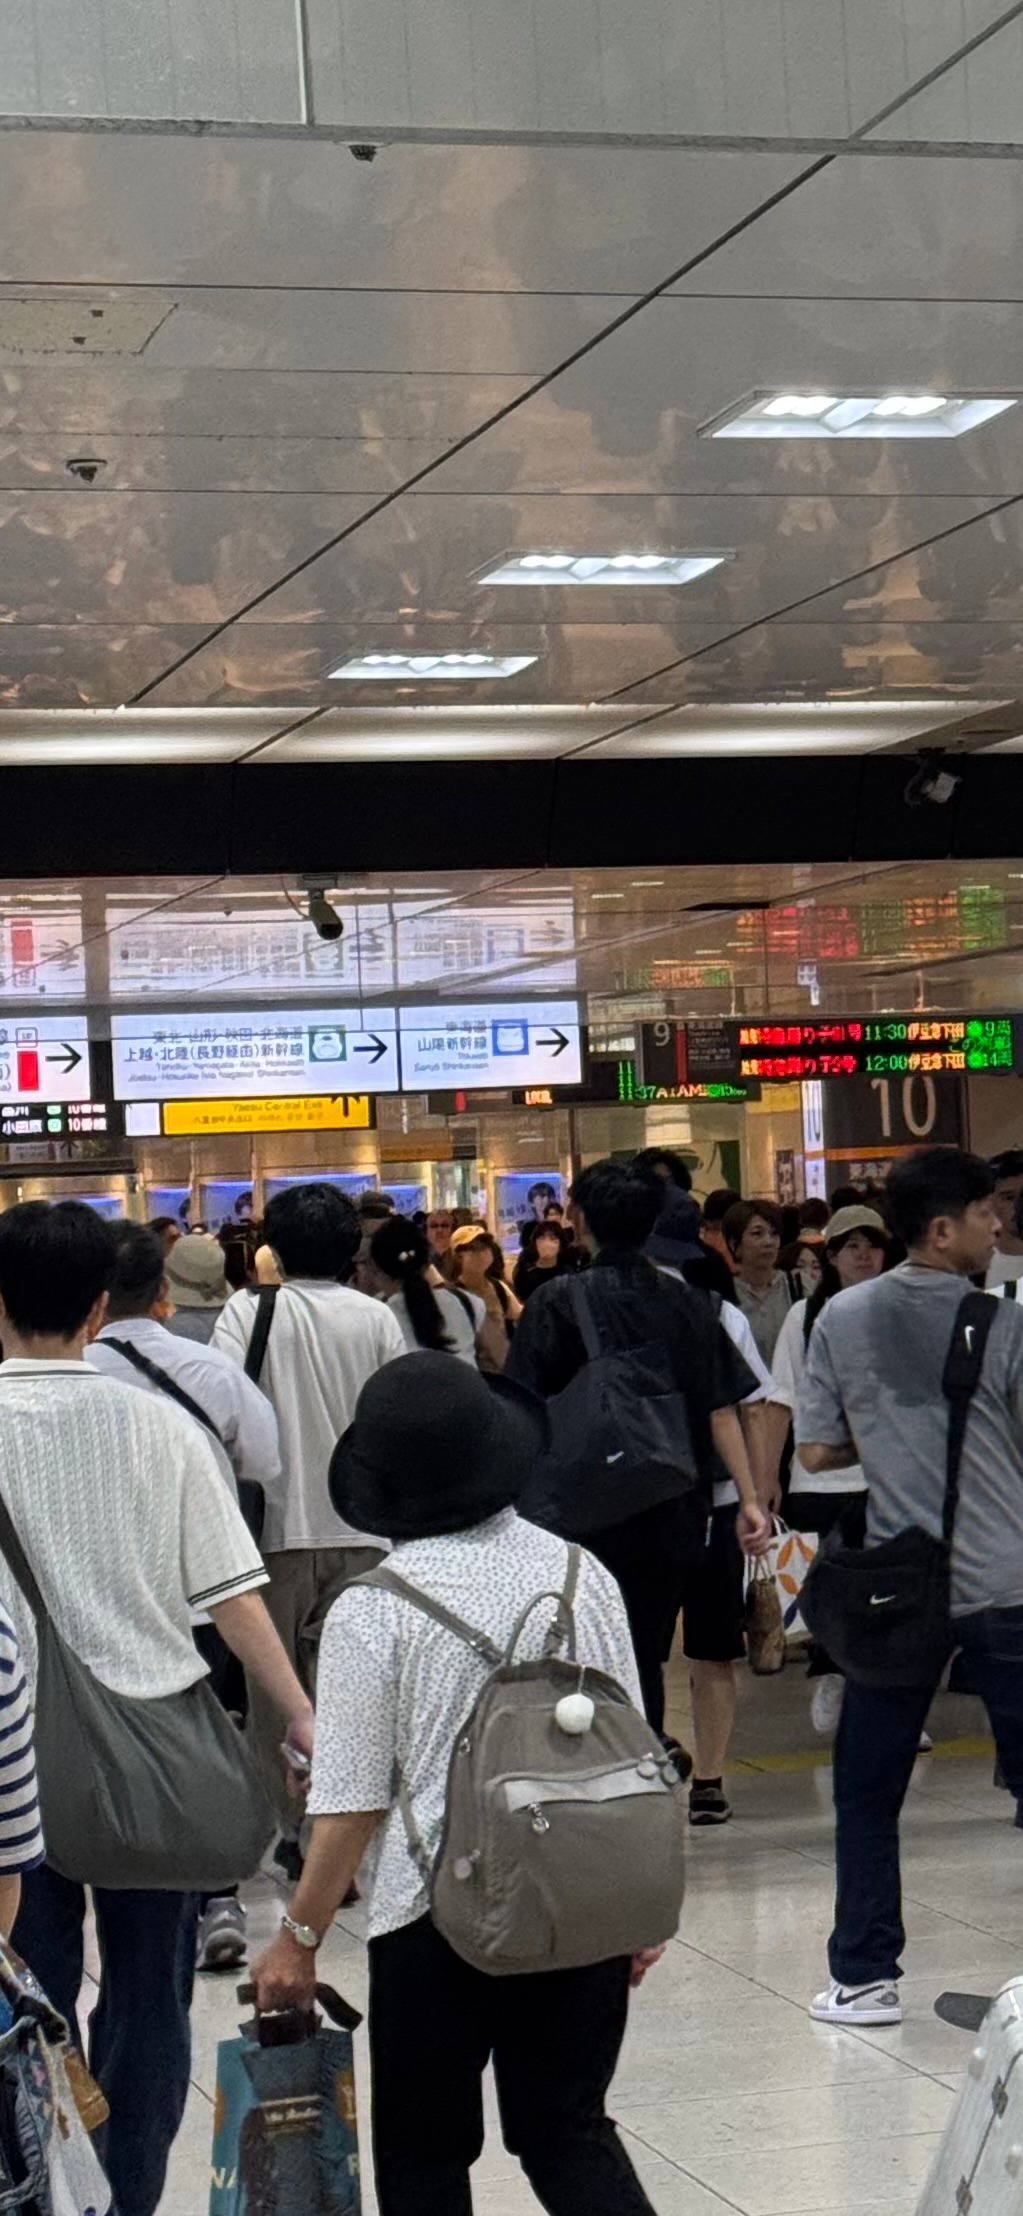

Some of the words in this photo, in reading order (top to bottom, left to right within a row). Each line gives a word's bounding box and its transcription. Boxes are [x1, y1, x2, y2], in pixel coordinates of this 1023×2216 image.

[653, 1022, 670, 1047] 9
[864, 1024, 907, 1041] 11:30
[865, 1054, 906, 1071] 12:00
[870, 1076, 936, 1137] 10
